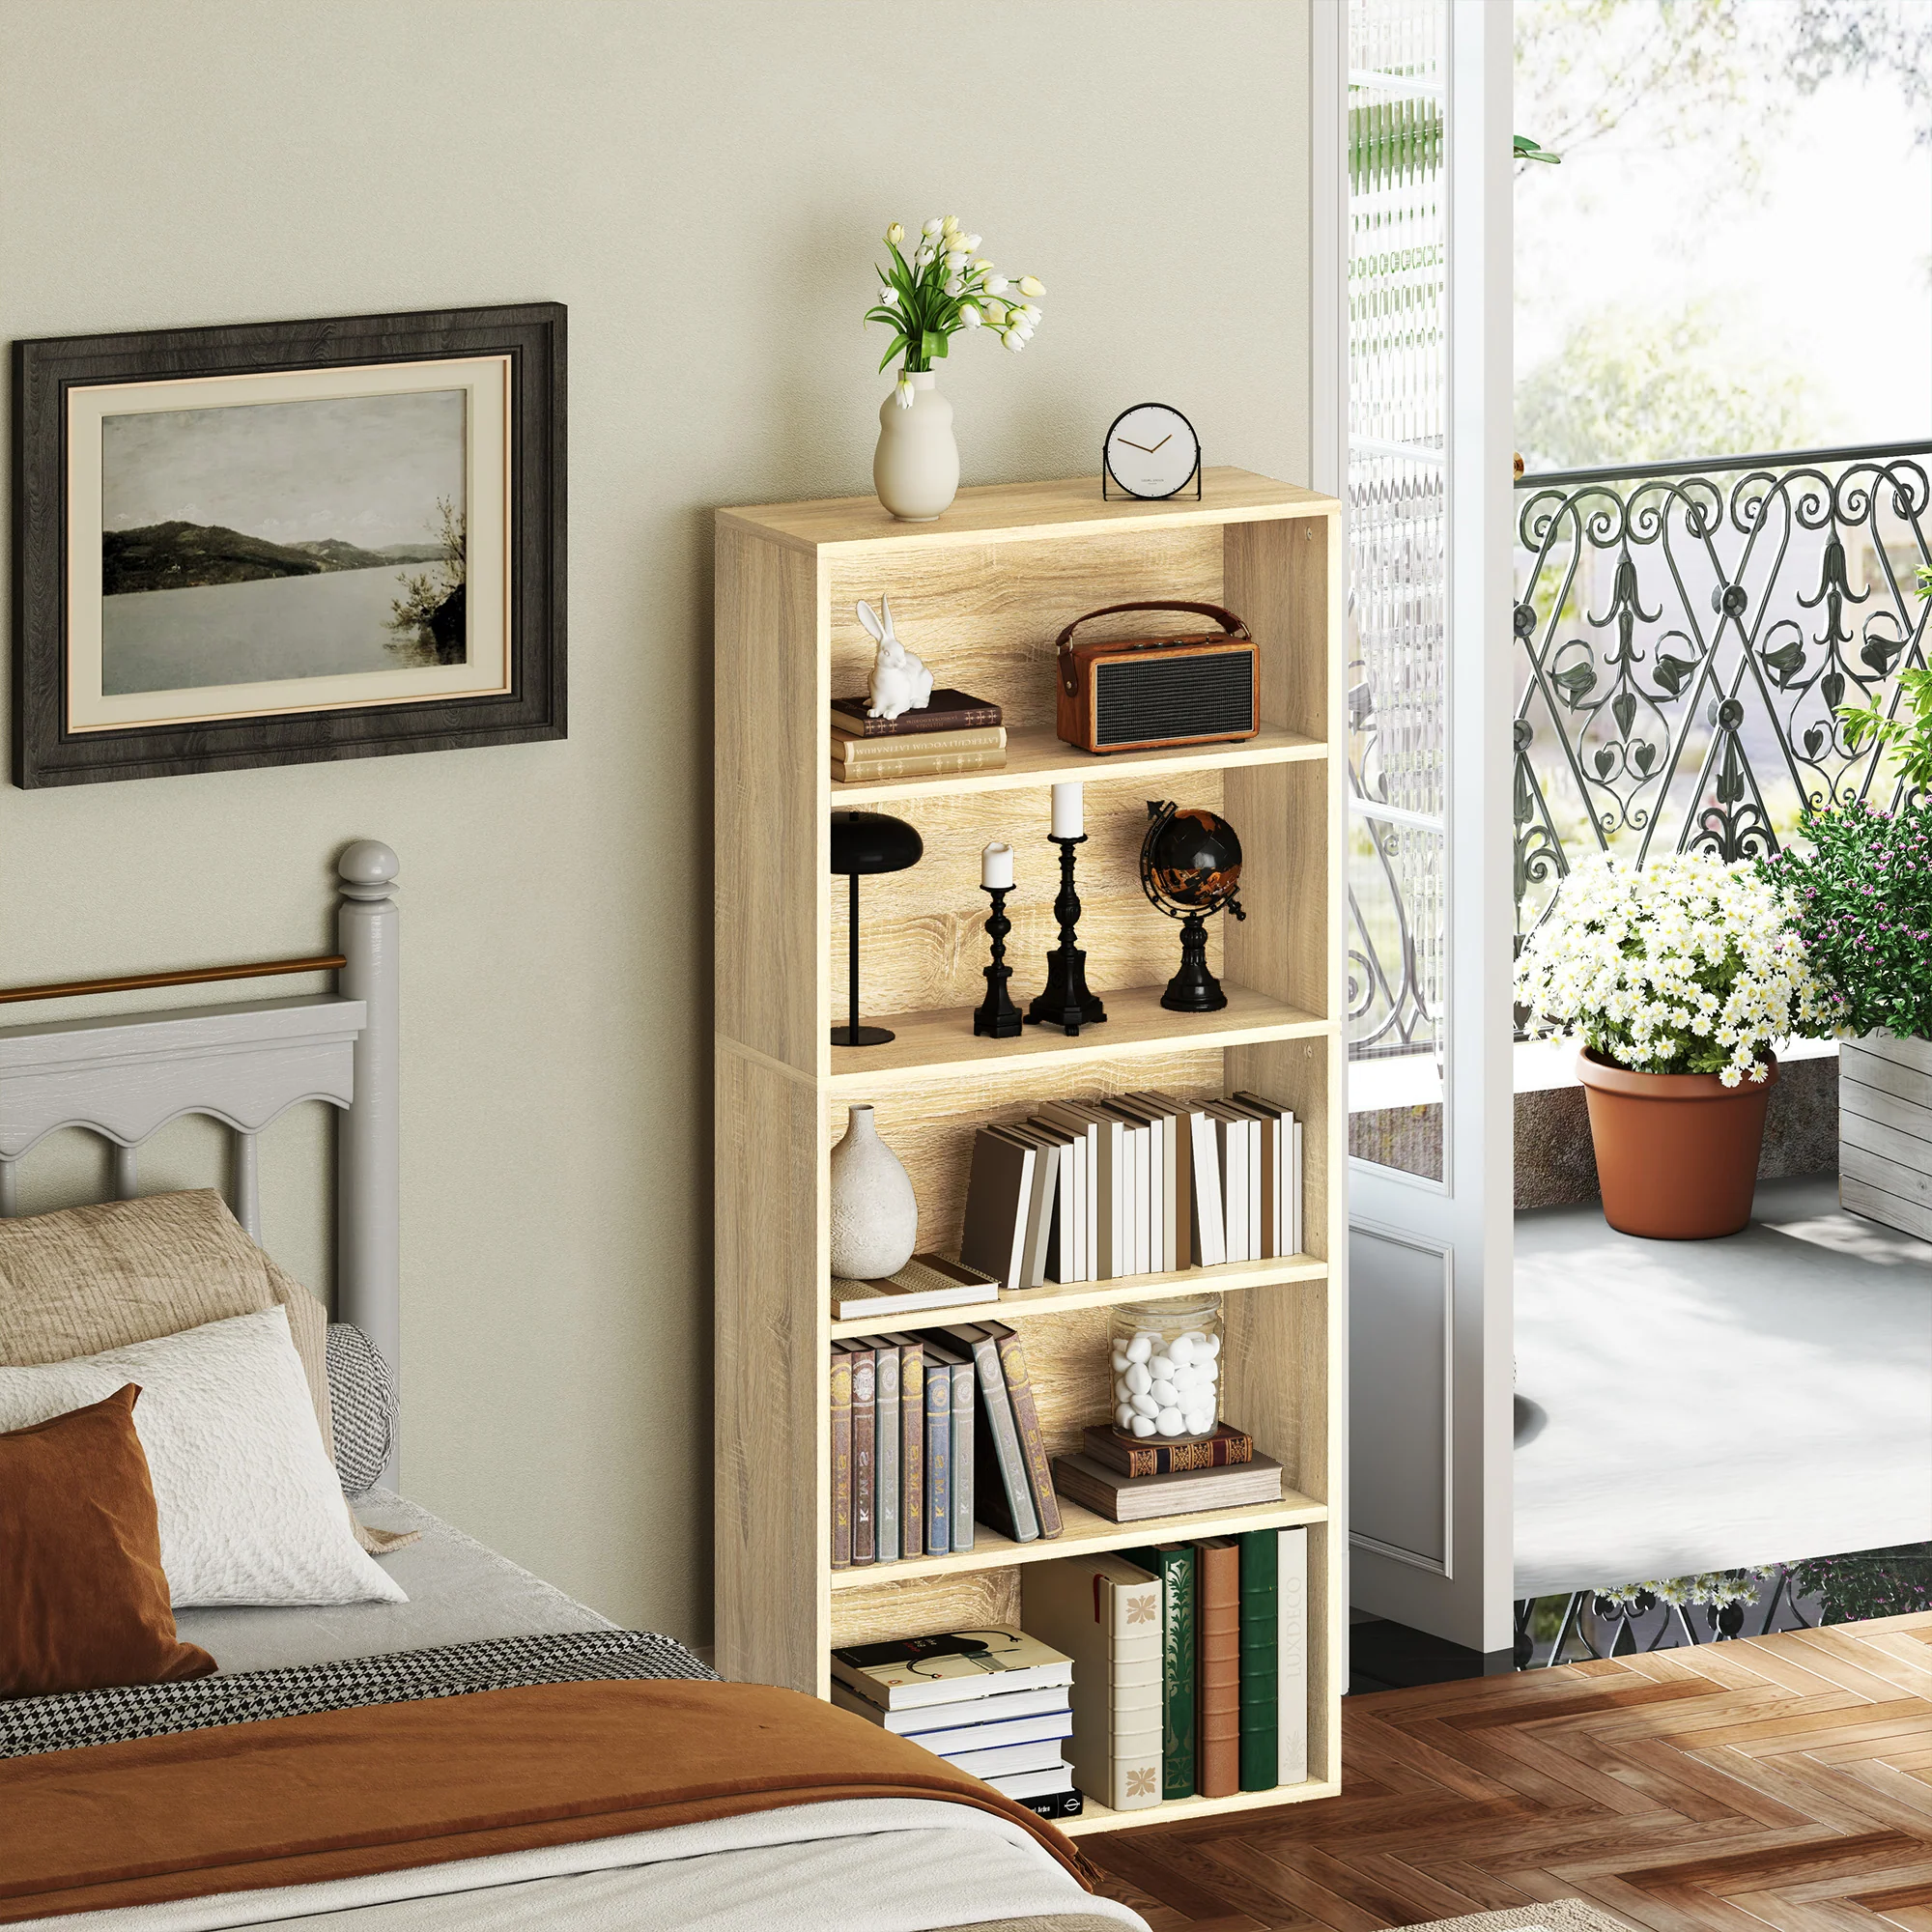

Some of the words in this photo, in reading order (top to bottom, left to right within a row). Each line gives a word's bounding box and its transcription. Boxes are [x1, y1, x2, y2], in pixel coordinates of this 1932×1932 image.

[912, 741, 948, 751] VOCUM
[950, 737, 999, 748] LATERCULI
[856, 745, 910, 754] LATINARUM
[1286, 1576, 1302, 1680] LUXDECO
